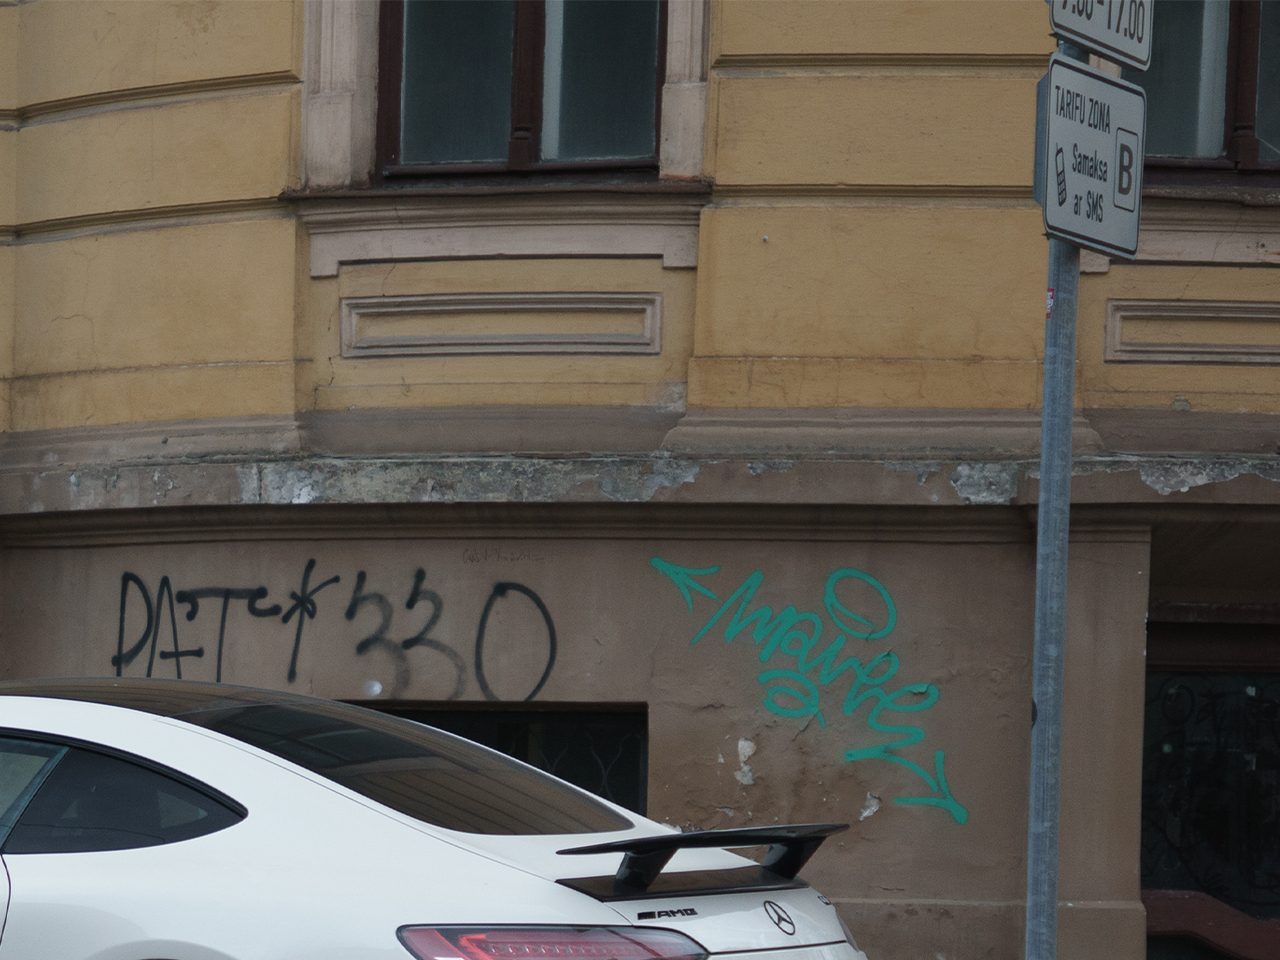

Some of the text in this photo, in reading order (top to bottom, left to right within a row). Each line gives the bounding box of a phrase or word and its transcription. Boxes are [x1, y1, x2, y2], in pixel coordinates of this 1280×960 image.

[1055, 85, 1111, 134] TARIFU ZONA
[1072, 143, 1108, 182] Samaksa
[1117, 143, 1133, 196] B
[1073, 190, 1104, 223] ar SMS
[657, 908, 698, 918] AMG
